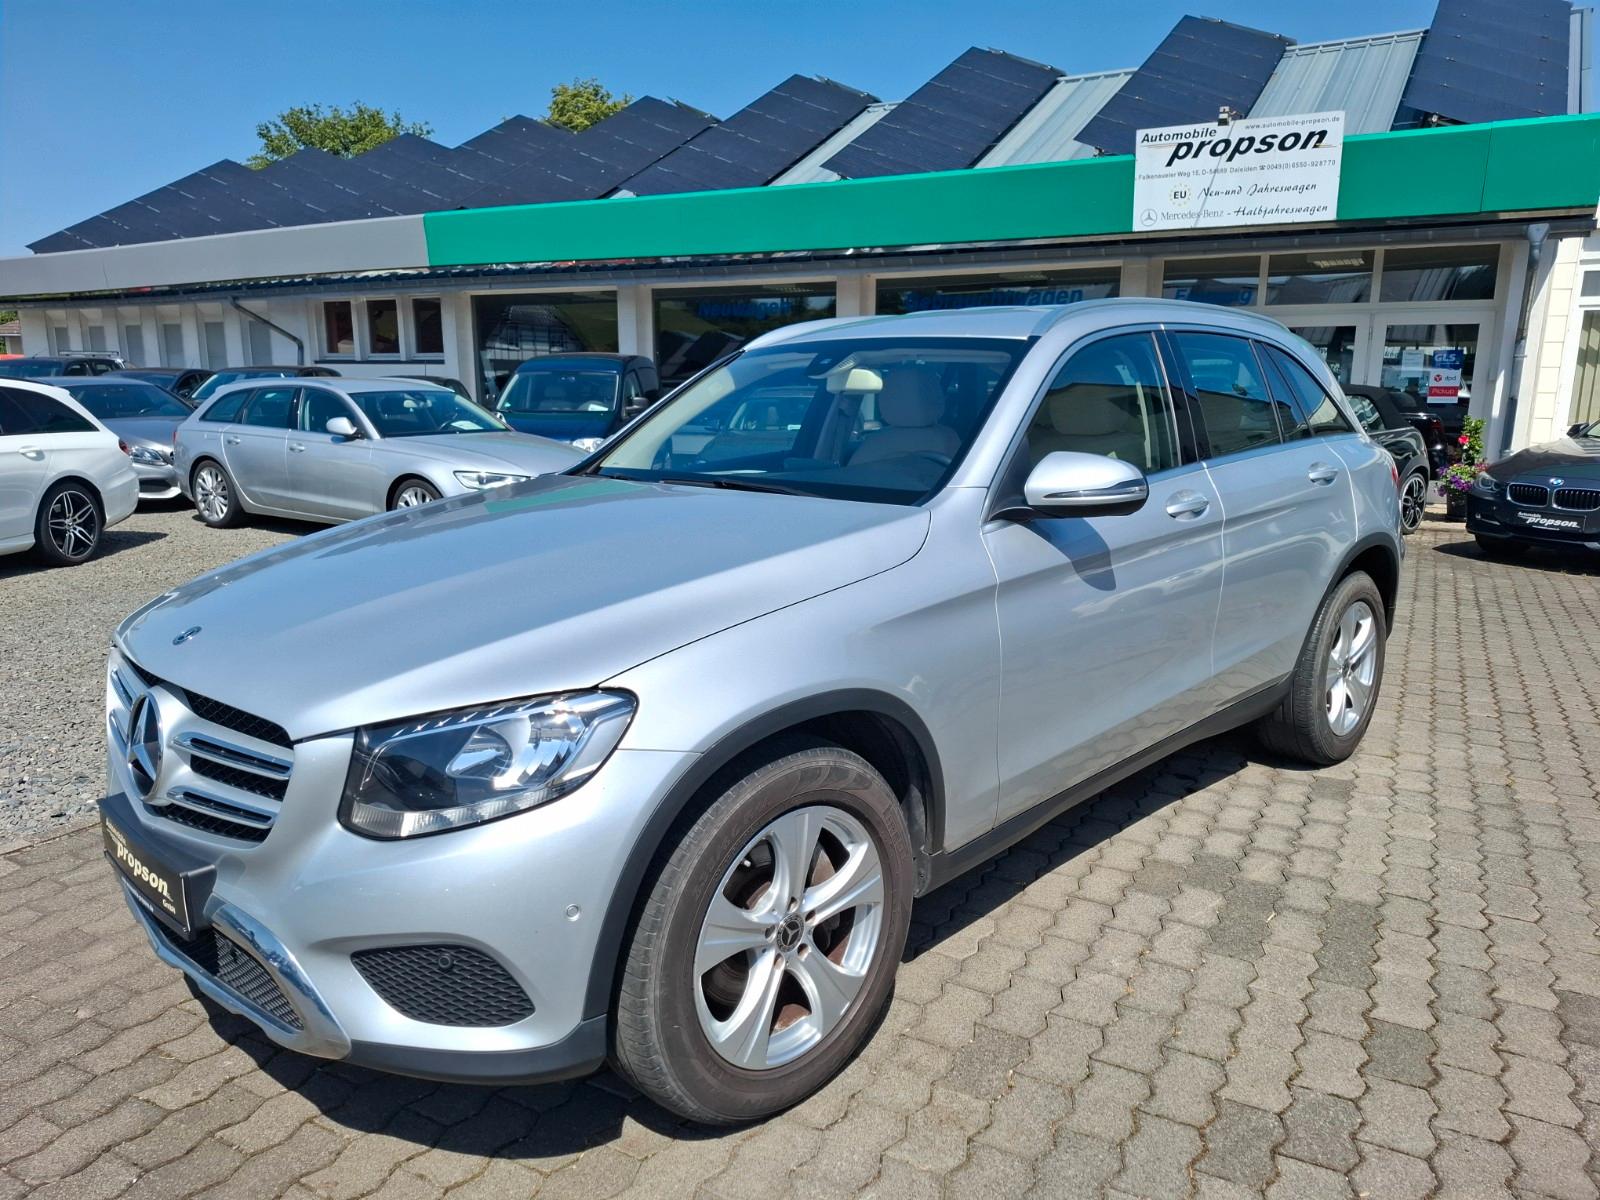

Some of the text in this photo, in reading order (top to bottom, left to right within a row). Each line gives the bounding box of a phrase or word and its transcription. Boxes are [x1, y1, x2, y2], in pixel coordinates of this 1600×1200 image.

[1141, 127, 1217, 144] Automobile
[1165, 129, 1328, 167] propson
[1173, 190, 1187, 200] EU
[1197, 183, 1317, 200] Neu-und Jahreswagen
[1161, 209, 1224, 221] Mercedes-Benz
[1233, 205, 1328, 218] Halbjahreswagen
[1434, 353, 1457, 362] GLS
[1526, 517, 1578, 528] propson
[117, 841, 169, 898] propson
